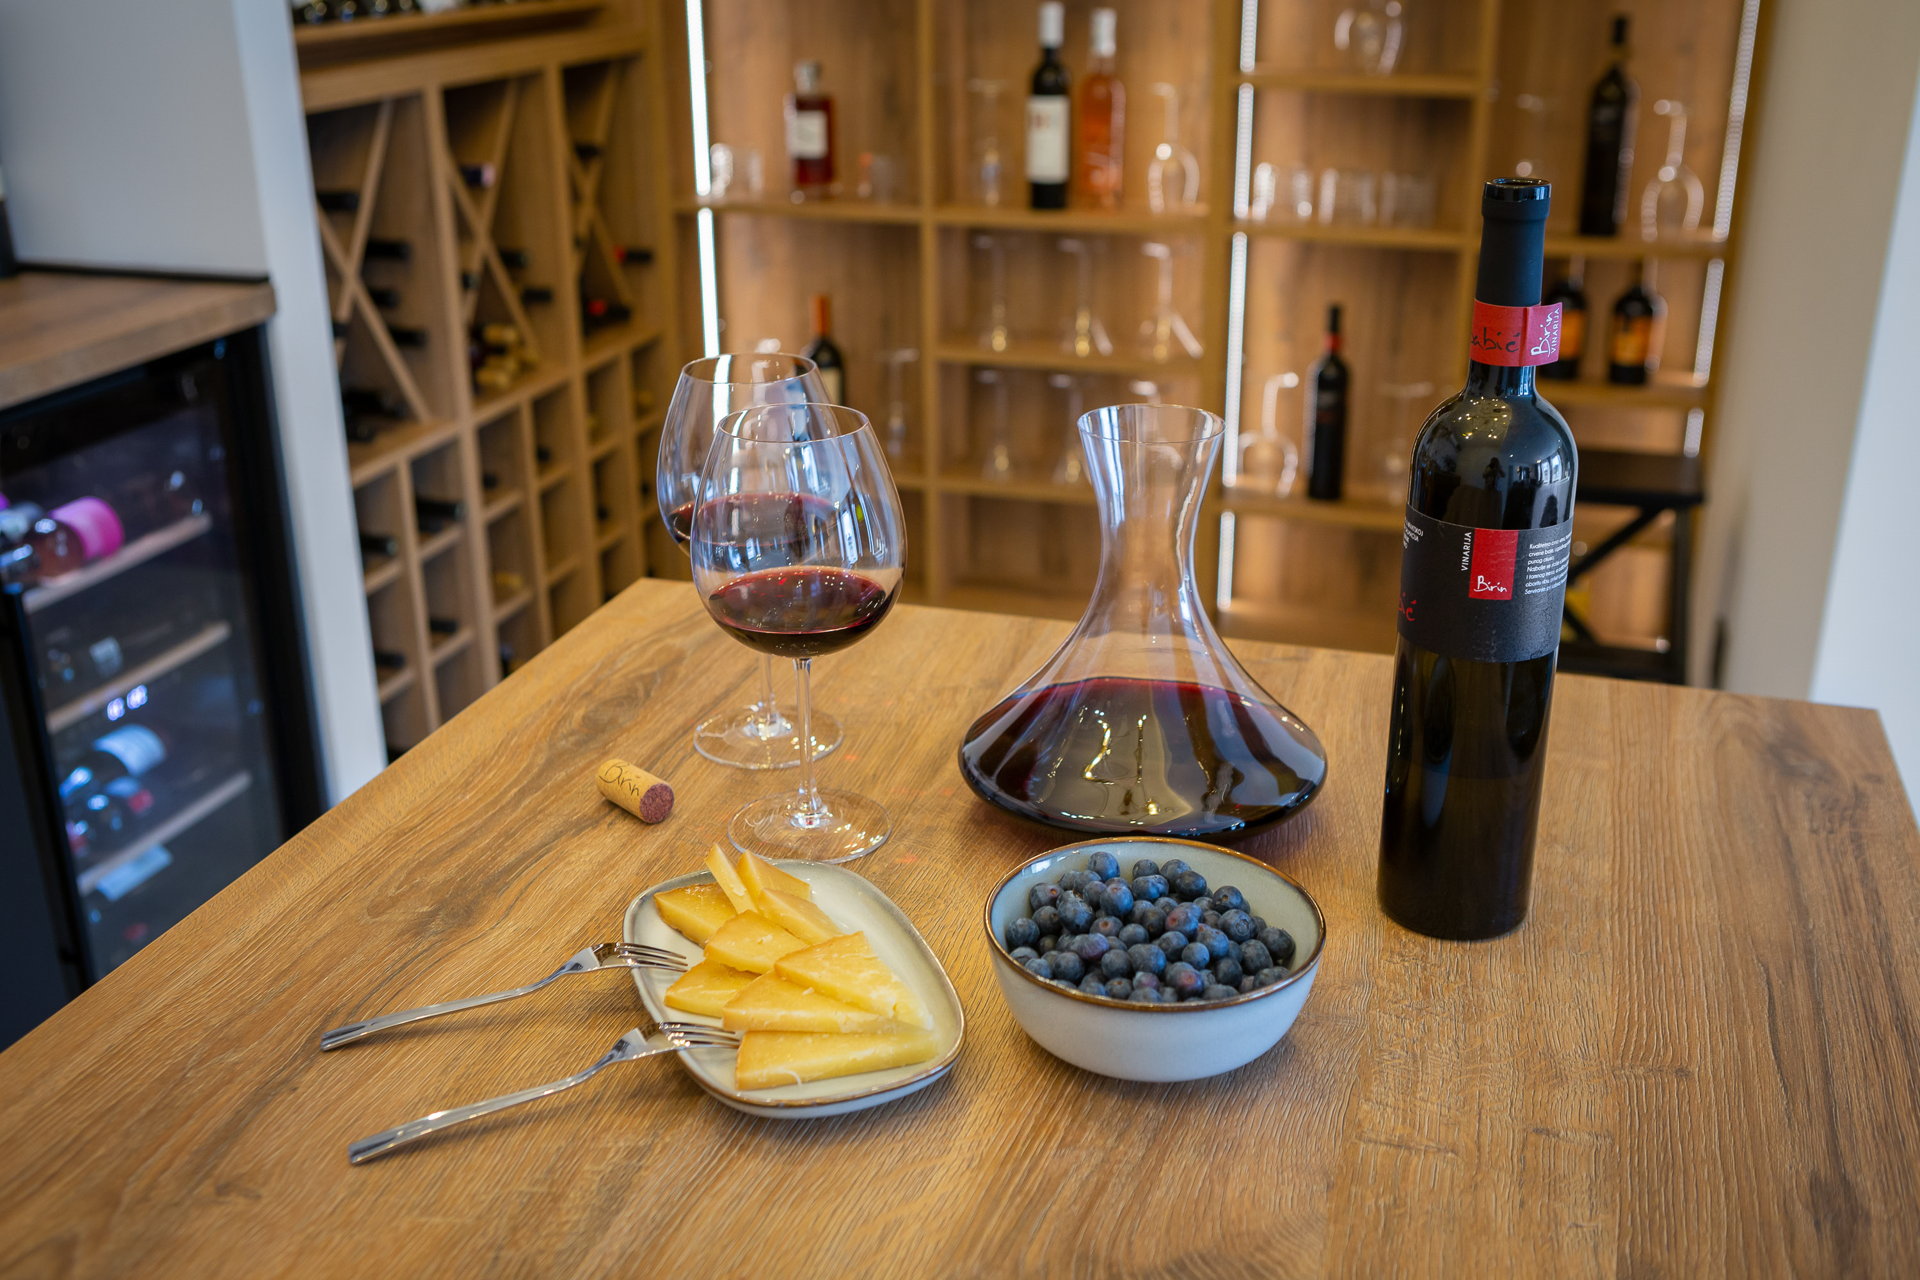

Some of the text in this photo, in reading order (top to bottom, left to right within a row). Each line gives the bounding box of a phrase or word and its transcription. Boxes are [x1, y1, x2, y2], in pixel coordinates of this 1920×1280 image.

[1471, 327, 1520, 352] abić
[1530, 311, 1553, 357] Birin
[1550, 307, 1560, 354] VINARIJA
[1460, 531, 1472, 571] VINARIJA
[1473, 575, 1508, 593] Birin
